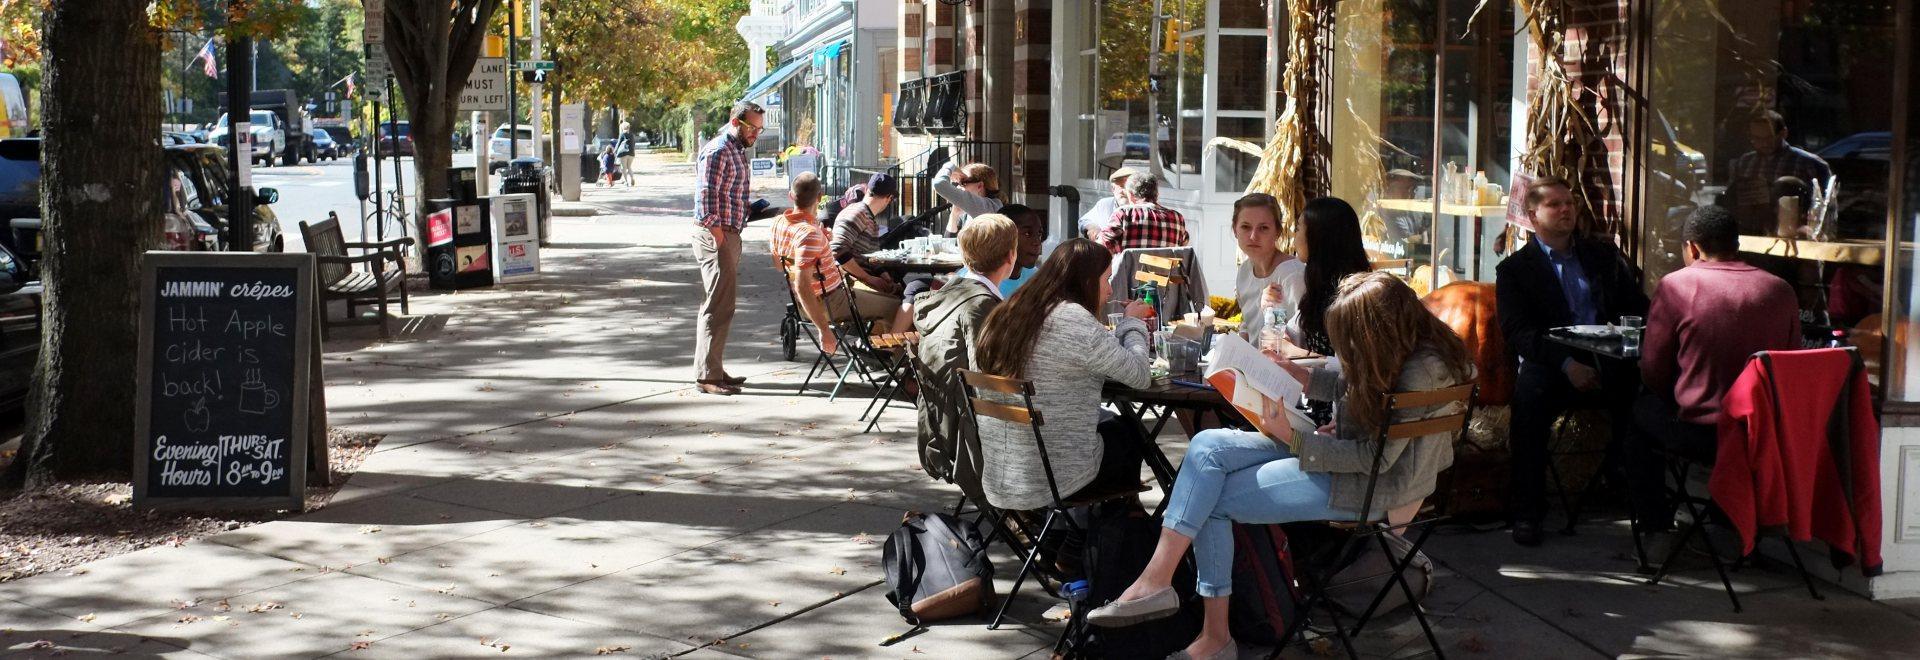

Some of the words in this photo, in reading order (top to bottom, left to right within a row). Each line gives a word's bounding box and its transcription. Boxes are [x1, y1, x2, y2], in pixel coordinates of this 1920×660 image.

[481, 65, 504, 73] LANE
[466, 80, 494, 89] MUST
[460, 96, 479, 104] URN
[484, 95, 504, 103] LEFT
[160, 281, 224, 297] JAMMIN'
[230, 281, 294, 301] crêpes
[169, 306, 208, 332] Hot
[224, 309, 287, 340] Apple
[166, 340, 226, 363] Cider
[239, 346, 259, 363] is
[162, 370, 225, 400] back!
[153, 435, 219, 467] Evening
[223, 435, 267, 457] THURS
[160, 460, 212, 486] Hours
